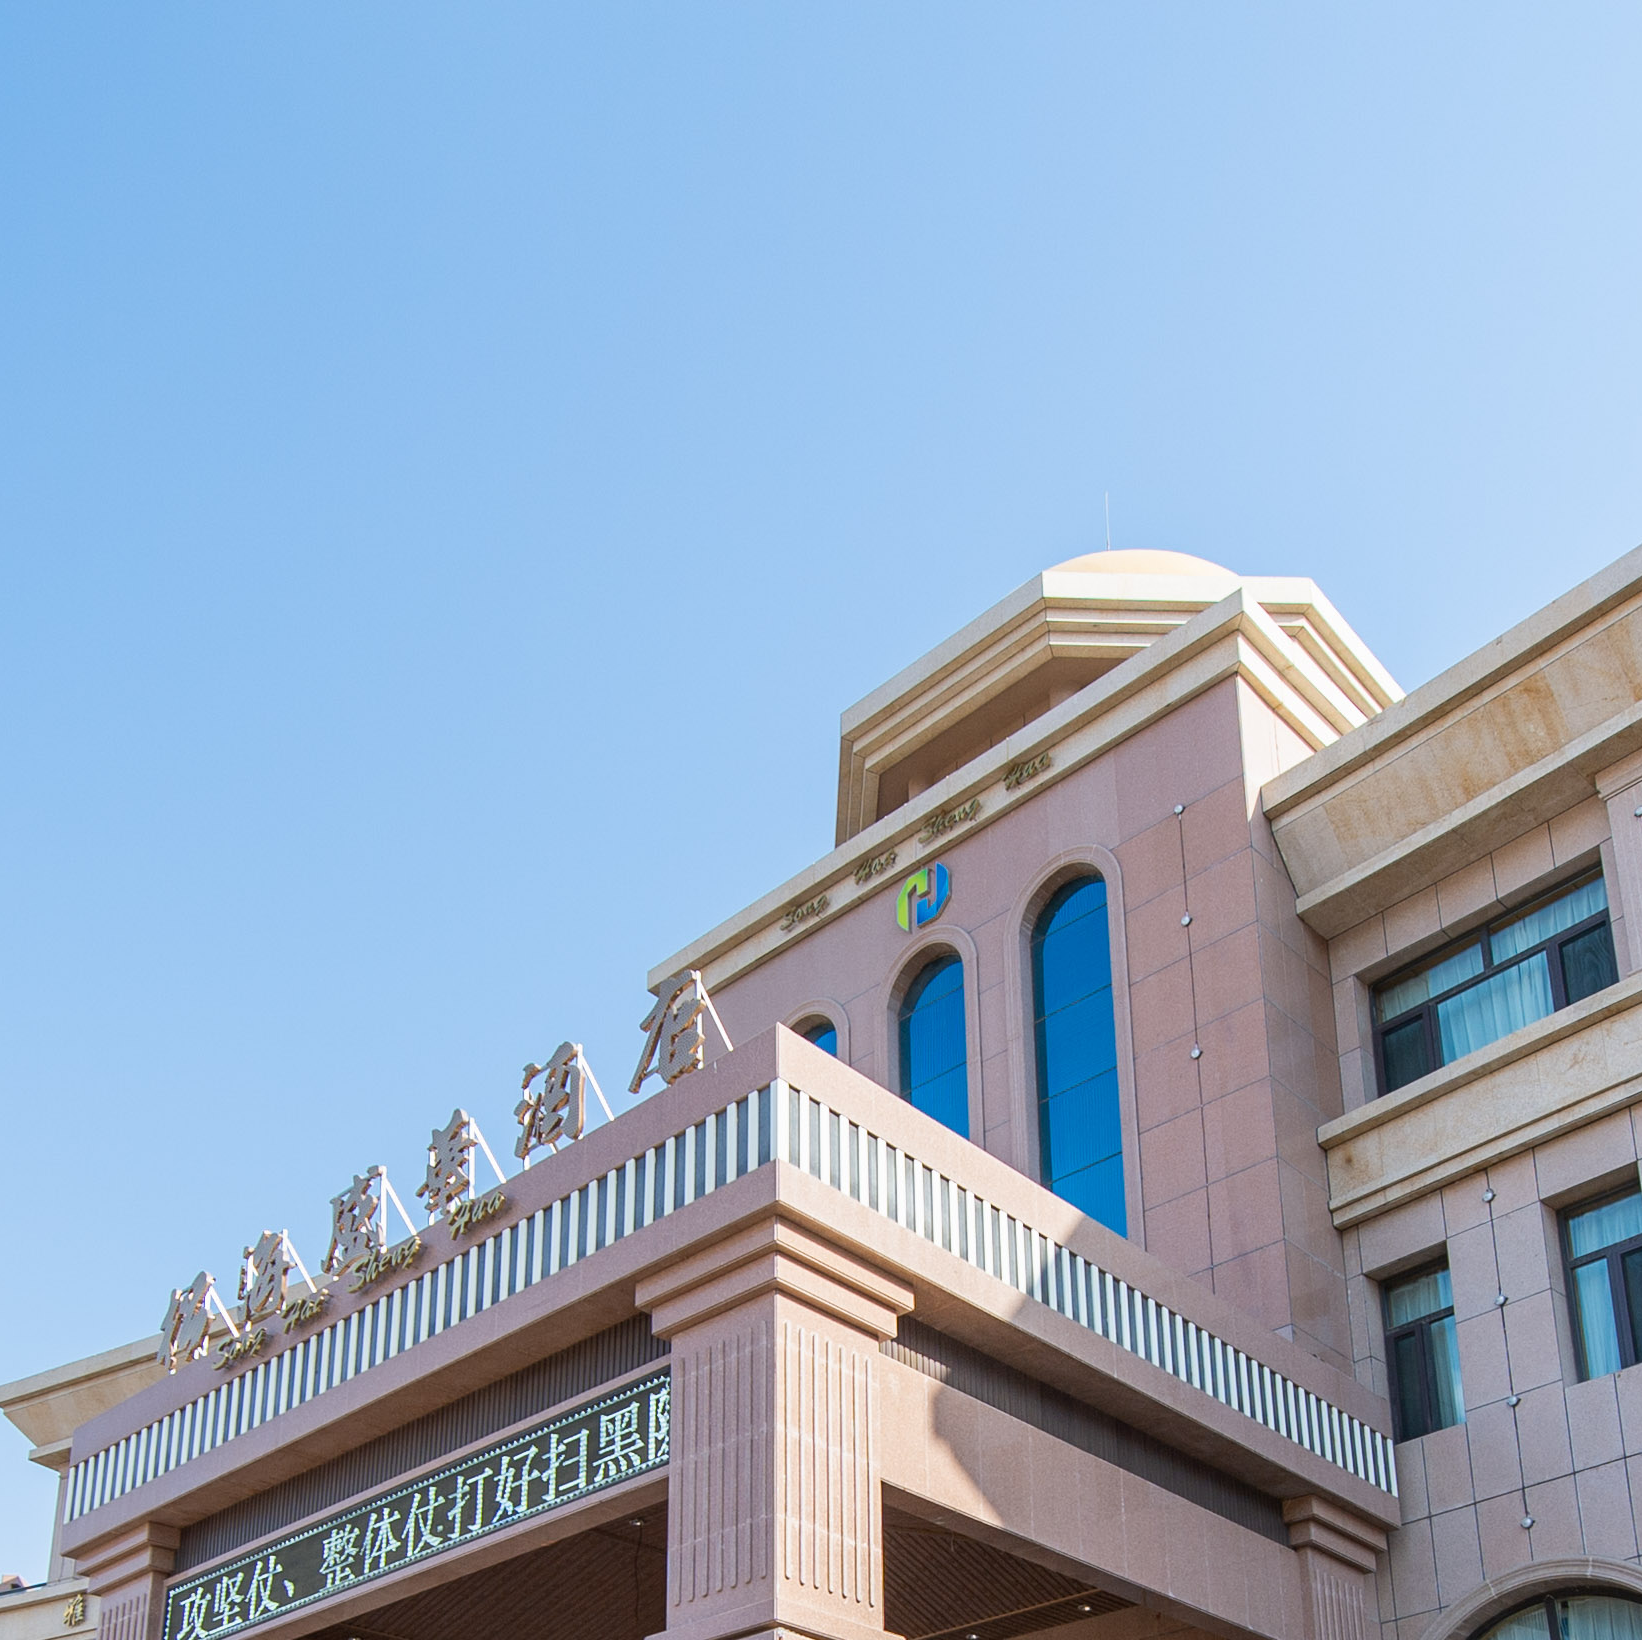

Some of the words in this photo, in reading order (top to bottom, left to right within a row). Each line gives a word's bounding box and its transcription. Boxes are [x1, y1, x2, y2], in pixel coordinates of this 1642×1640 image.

[779, 894, 831, 931] Song
[212, 1327, 268, 1371] Song
[347, 1235, 422, 1294] Sheng
[448, 1191, 507, 1240] Hua
